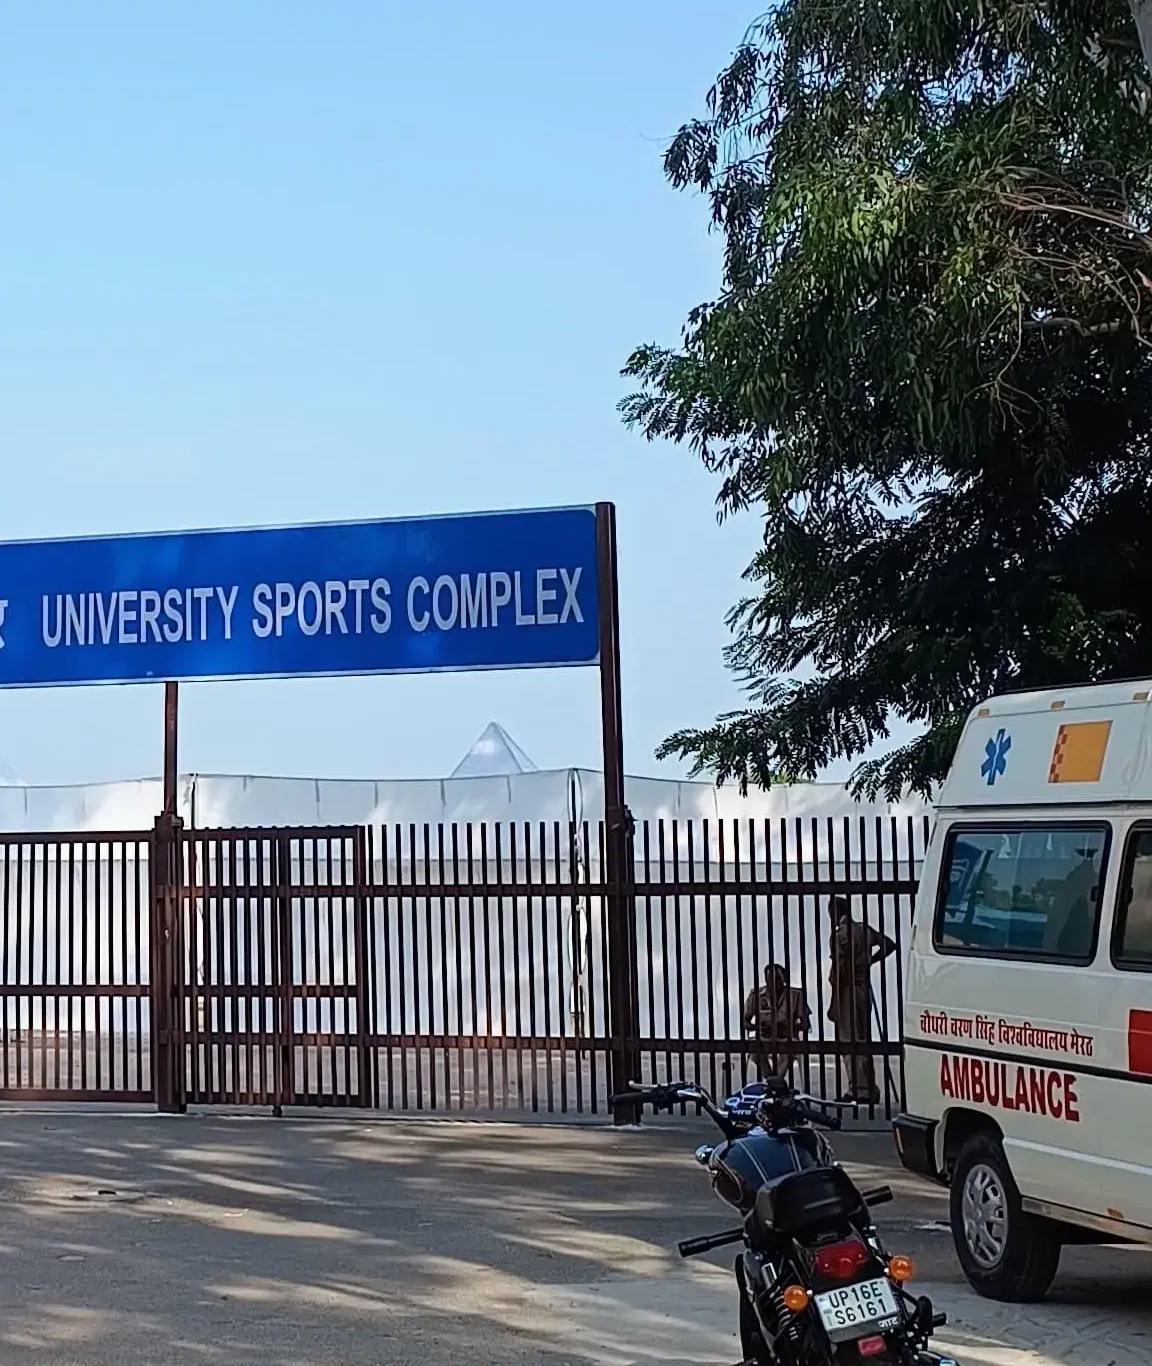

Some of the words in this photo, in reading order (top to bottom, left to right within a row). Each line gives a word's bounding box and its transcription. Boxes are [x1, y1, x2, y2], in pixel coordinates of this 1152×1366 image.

[42, 585, 240, 648] UNIVERSITY
[251, 578, 393, 638] SPORTS
[406, 567, 585, 632] COMPLEX
[950, 1018, 973, 1038] चरण
[975, 1015, 995, 1045] सिंह
[998, 1019, 1068, 1052] विश्वविद्यालय
[1070, 1028, 1094, 1056] मेरठ
[940, 1054, 1080, 1122] AMBULANCE
[828, 1281, 883, 1309] UP16E
[834, 1298, 887, 1325] S6161
